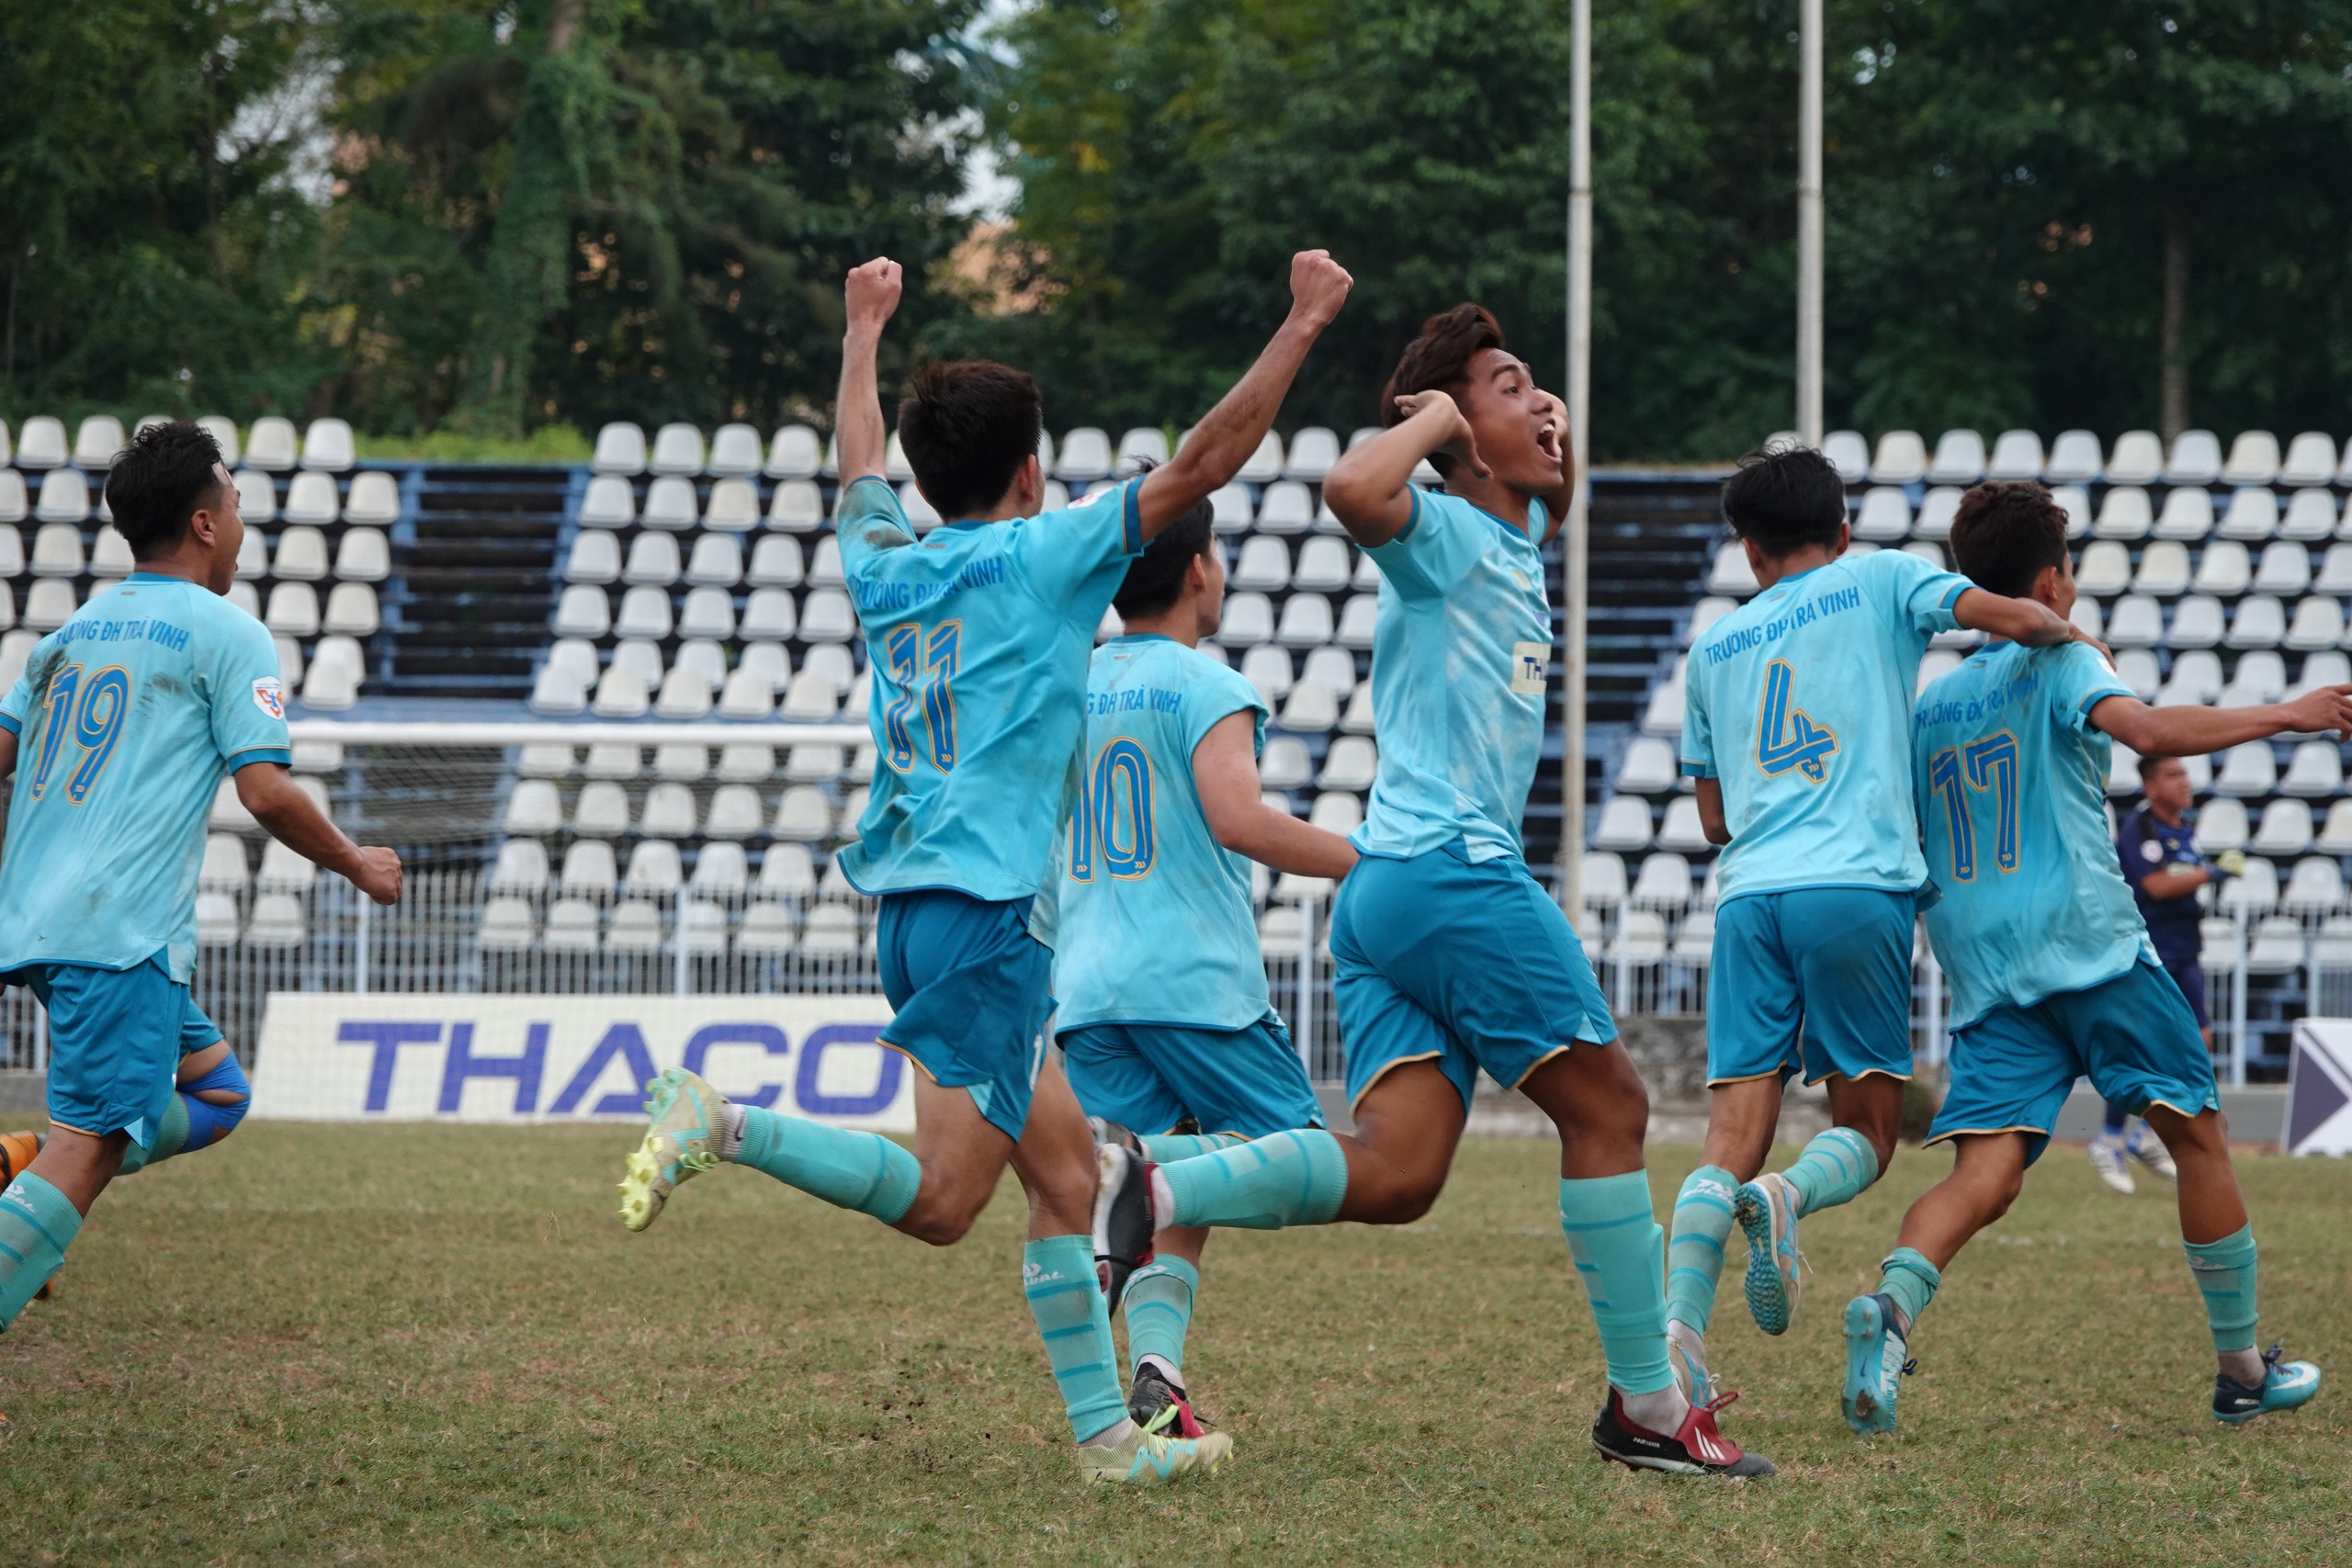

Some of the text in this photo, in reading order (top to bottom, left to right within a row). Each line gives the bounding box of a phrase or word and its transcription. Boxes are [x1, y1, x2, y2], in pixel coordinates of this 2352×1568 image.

[100, 620, 124, 642] ĐH
[148, 618, 190, 652] VINH
[1818, 586, 1860, 616] VINH
[32, 663, 132, 806] 19
[886, 618, 962, 776] 11
[1098, 692, 1118, 716] ĐH
[1119, 683, 1145, 713] TRÀ
[1756, 658, 1839, 784] 4
[1069, 737, 1158, 885] 10
[1930, 728, 2019, 884] 17
[337, 1021, 904, 1117] THACO
